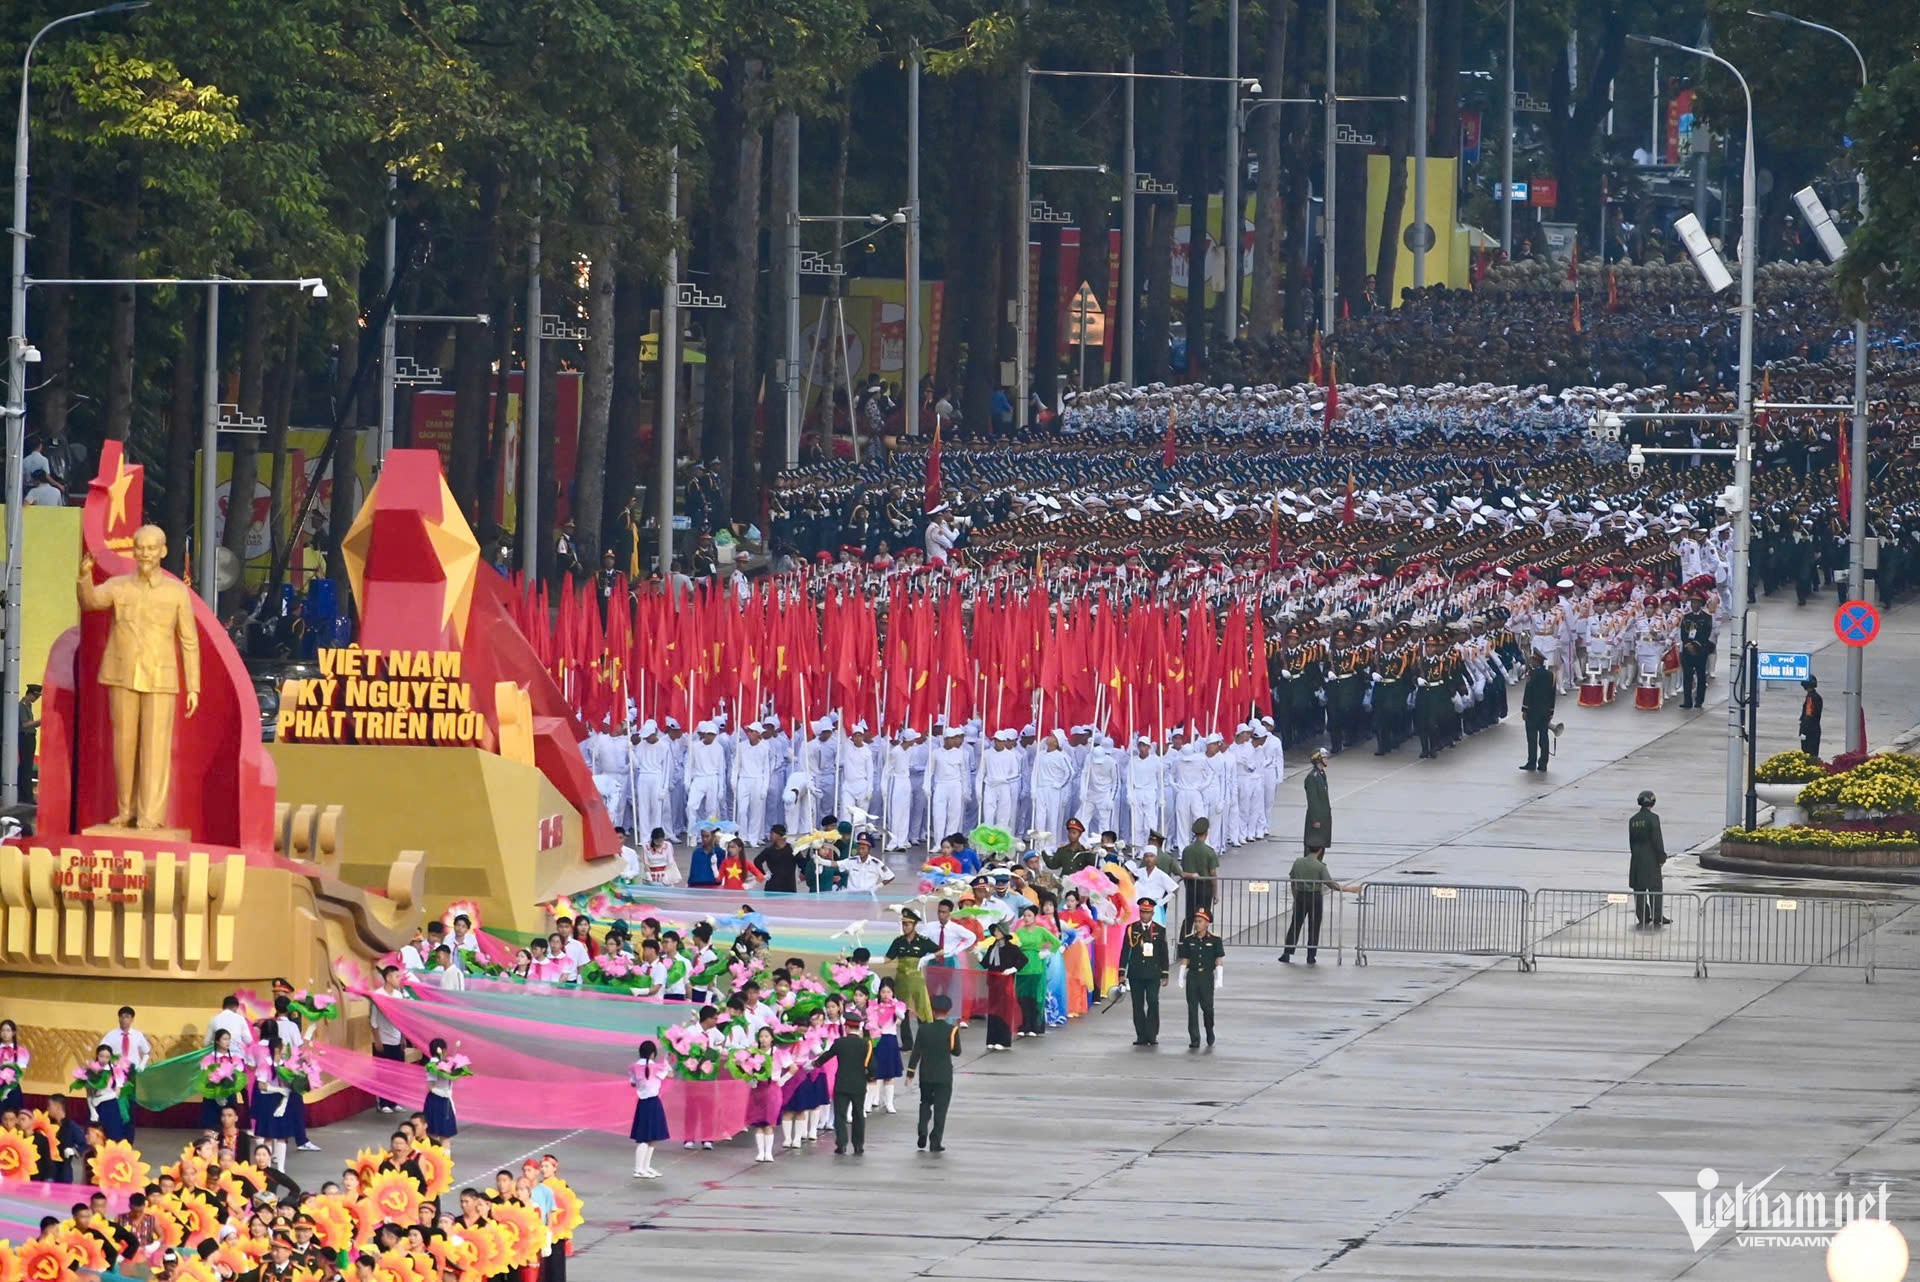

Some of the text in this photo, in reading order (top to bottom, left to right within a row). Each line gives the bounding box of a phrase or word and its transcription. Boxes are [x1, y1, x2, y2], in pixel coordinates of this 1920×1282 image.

[317, 643, 462, 682] VIỆT NAM
[345, 676, 471, 710] NGUYÊN
[277, 704, 484, 741] PHÁT TRIỂN MỚI
[79, 870, 103, 889] CHÍ
